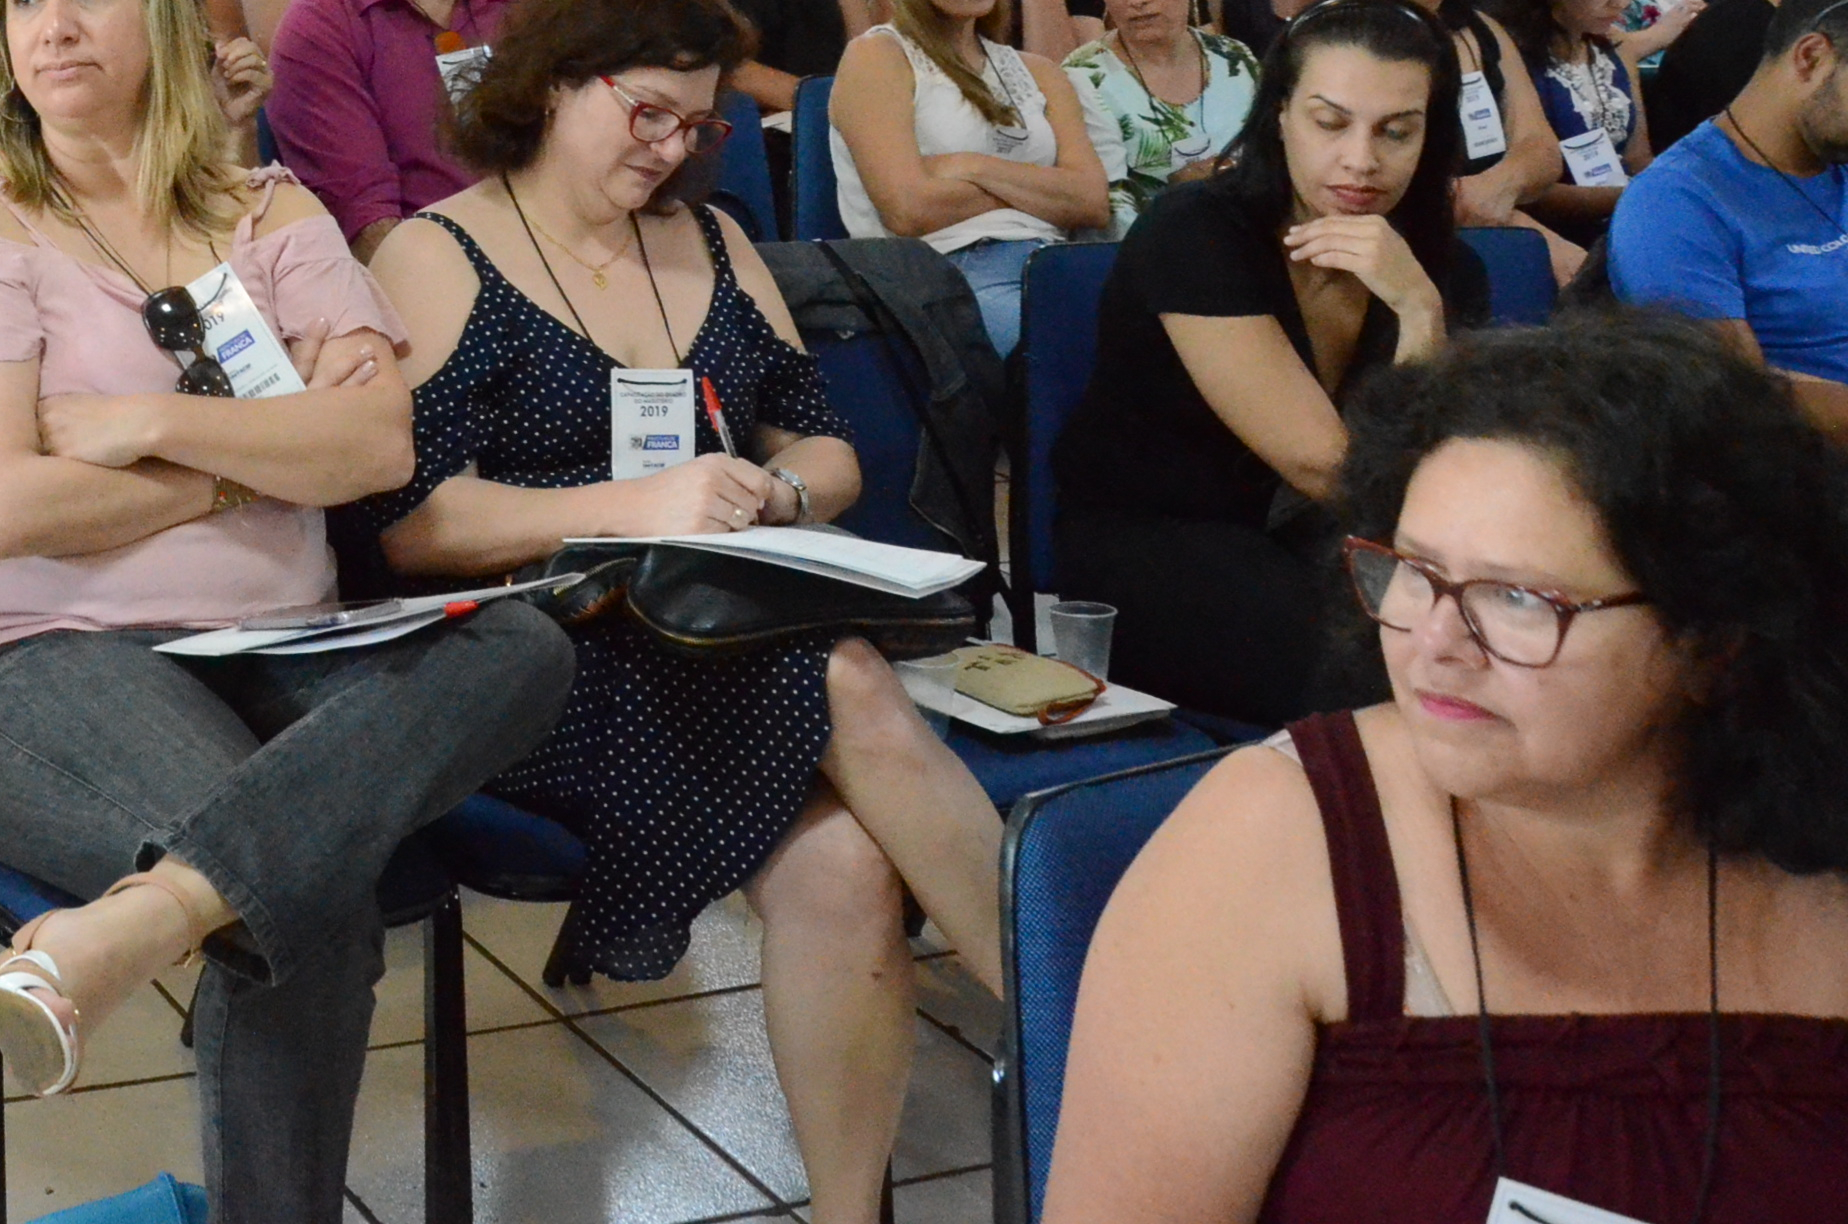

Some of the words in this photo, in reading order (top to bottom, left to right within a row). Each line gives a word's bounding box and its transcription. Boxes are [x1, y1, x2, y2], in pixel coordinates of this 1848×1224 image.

[203, 312, 225, 331] 019
[221, 337, 253, 360] FRANCA
[640, 405, 668, 417] 2019
[646, 441, 677, 449] FRANCA
